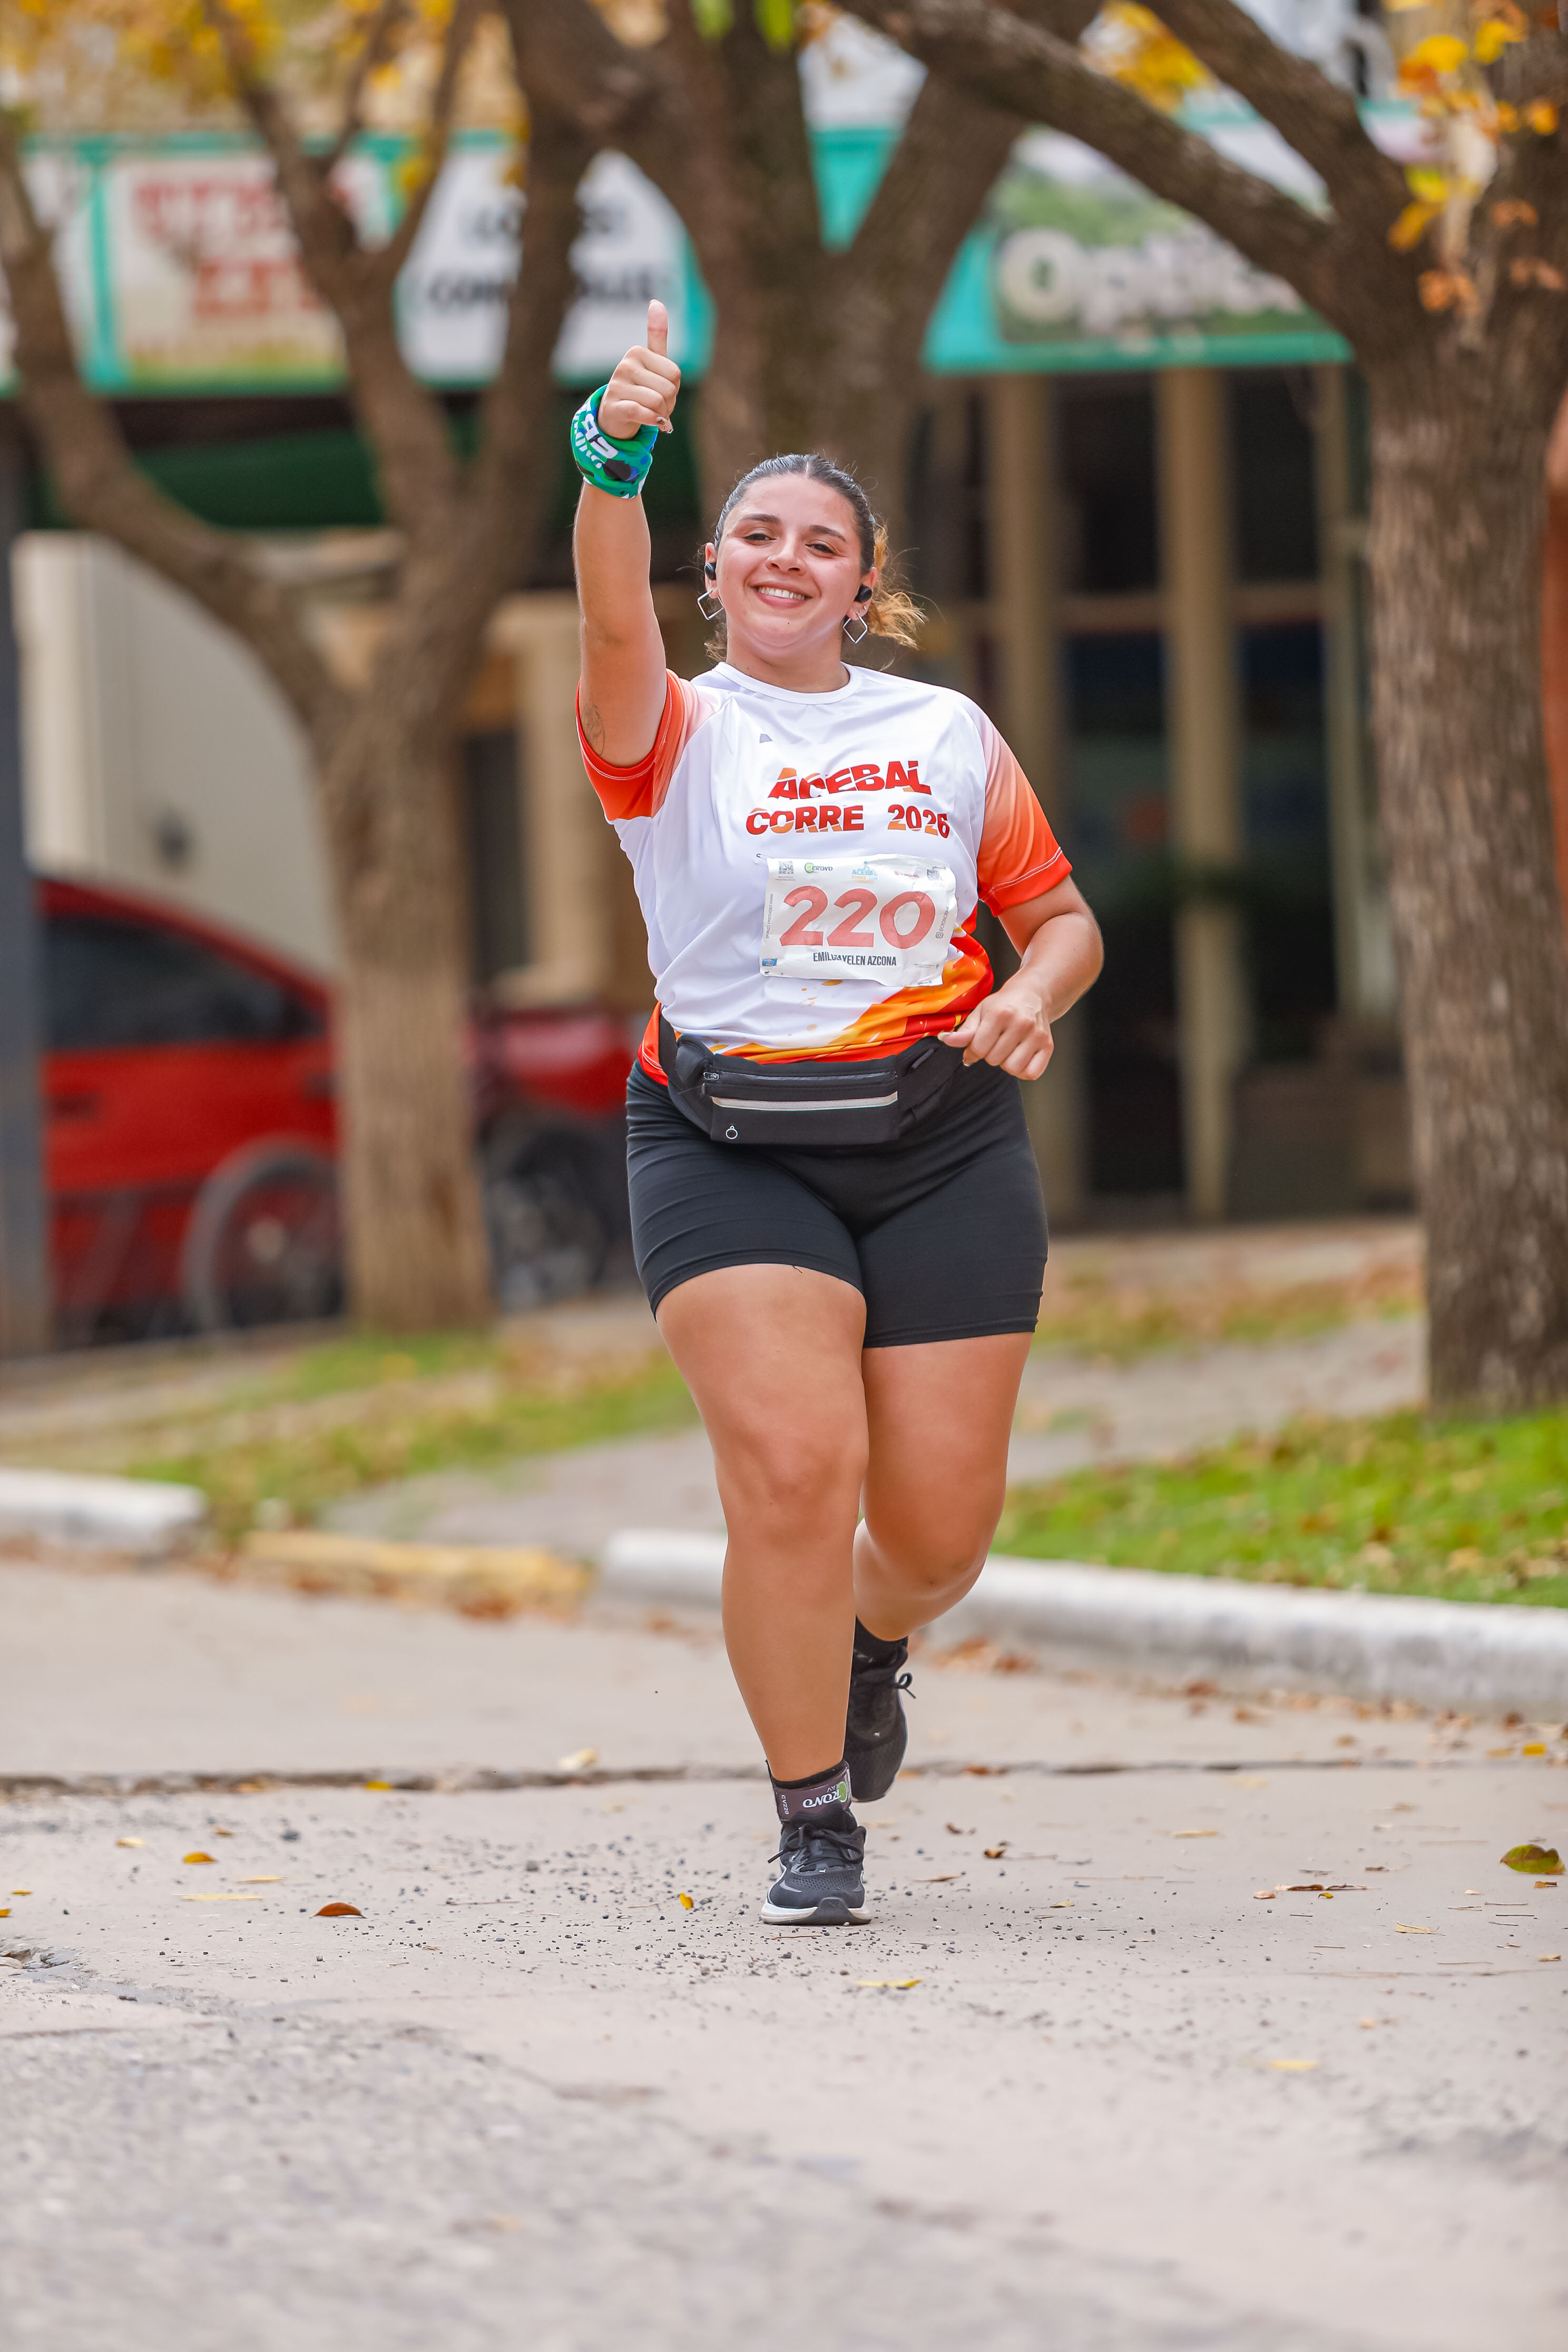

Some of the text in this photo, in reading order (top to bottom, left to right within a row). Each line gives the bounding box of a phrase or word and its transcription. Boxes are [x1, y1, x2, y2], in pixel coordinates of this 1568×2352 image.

[768, 760, 932, 800] ACEBAL
[746, 804, 950, 838] CORRE 2026
[779, 885, 936, 949] 220
[867, 956, 897, 966] AZCONA
[781, 1794, 790, 1815] CV220
